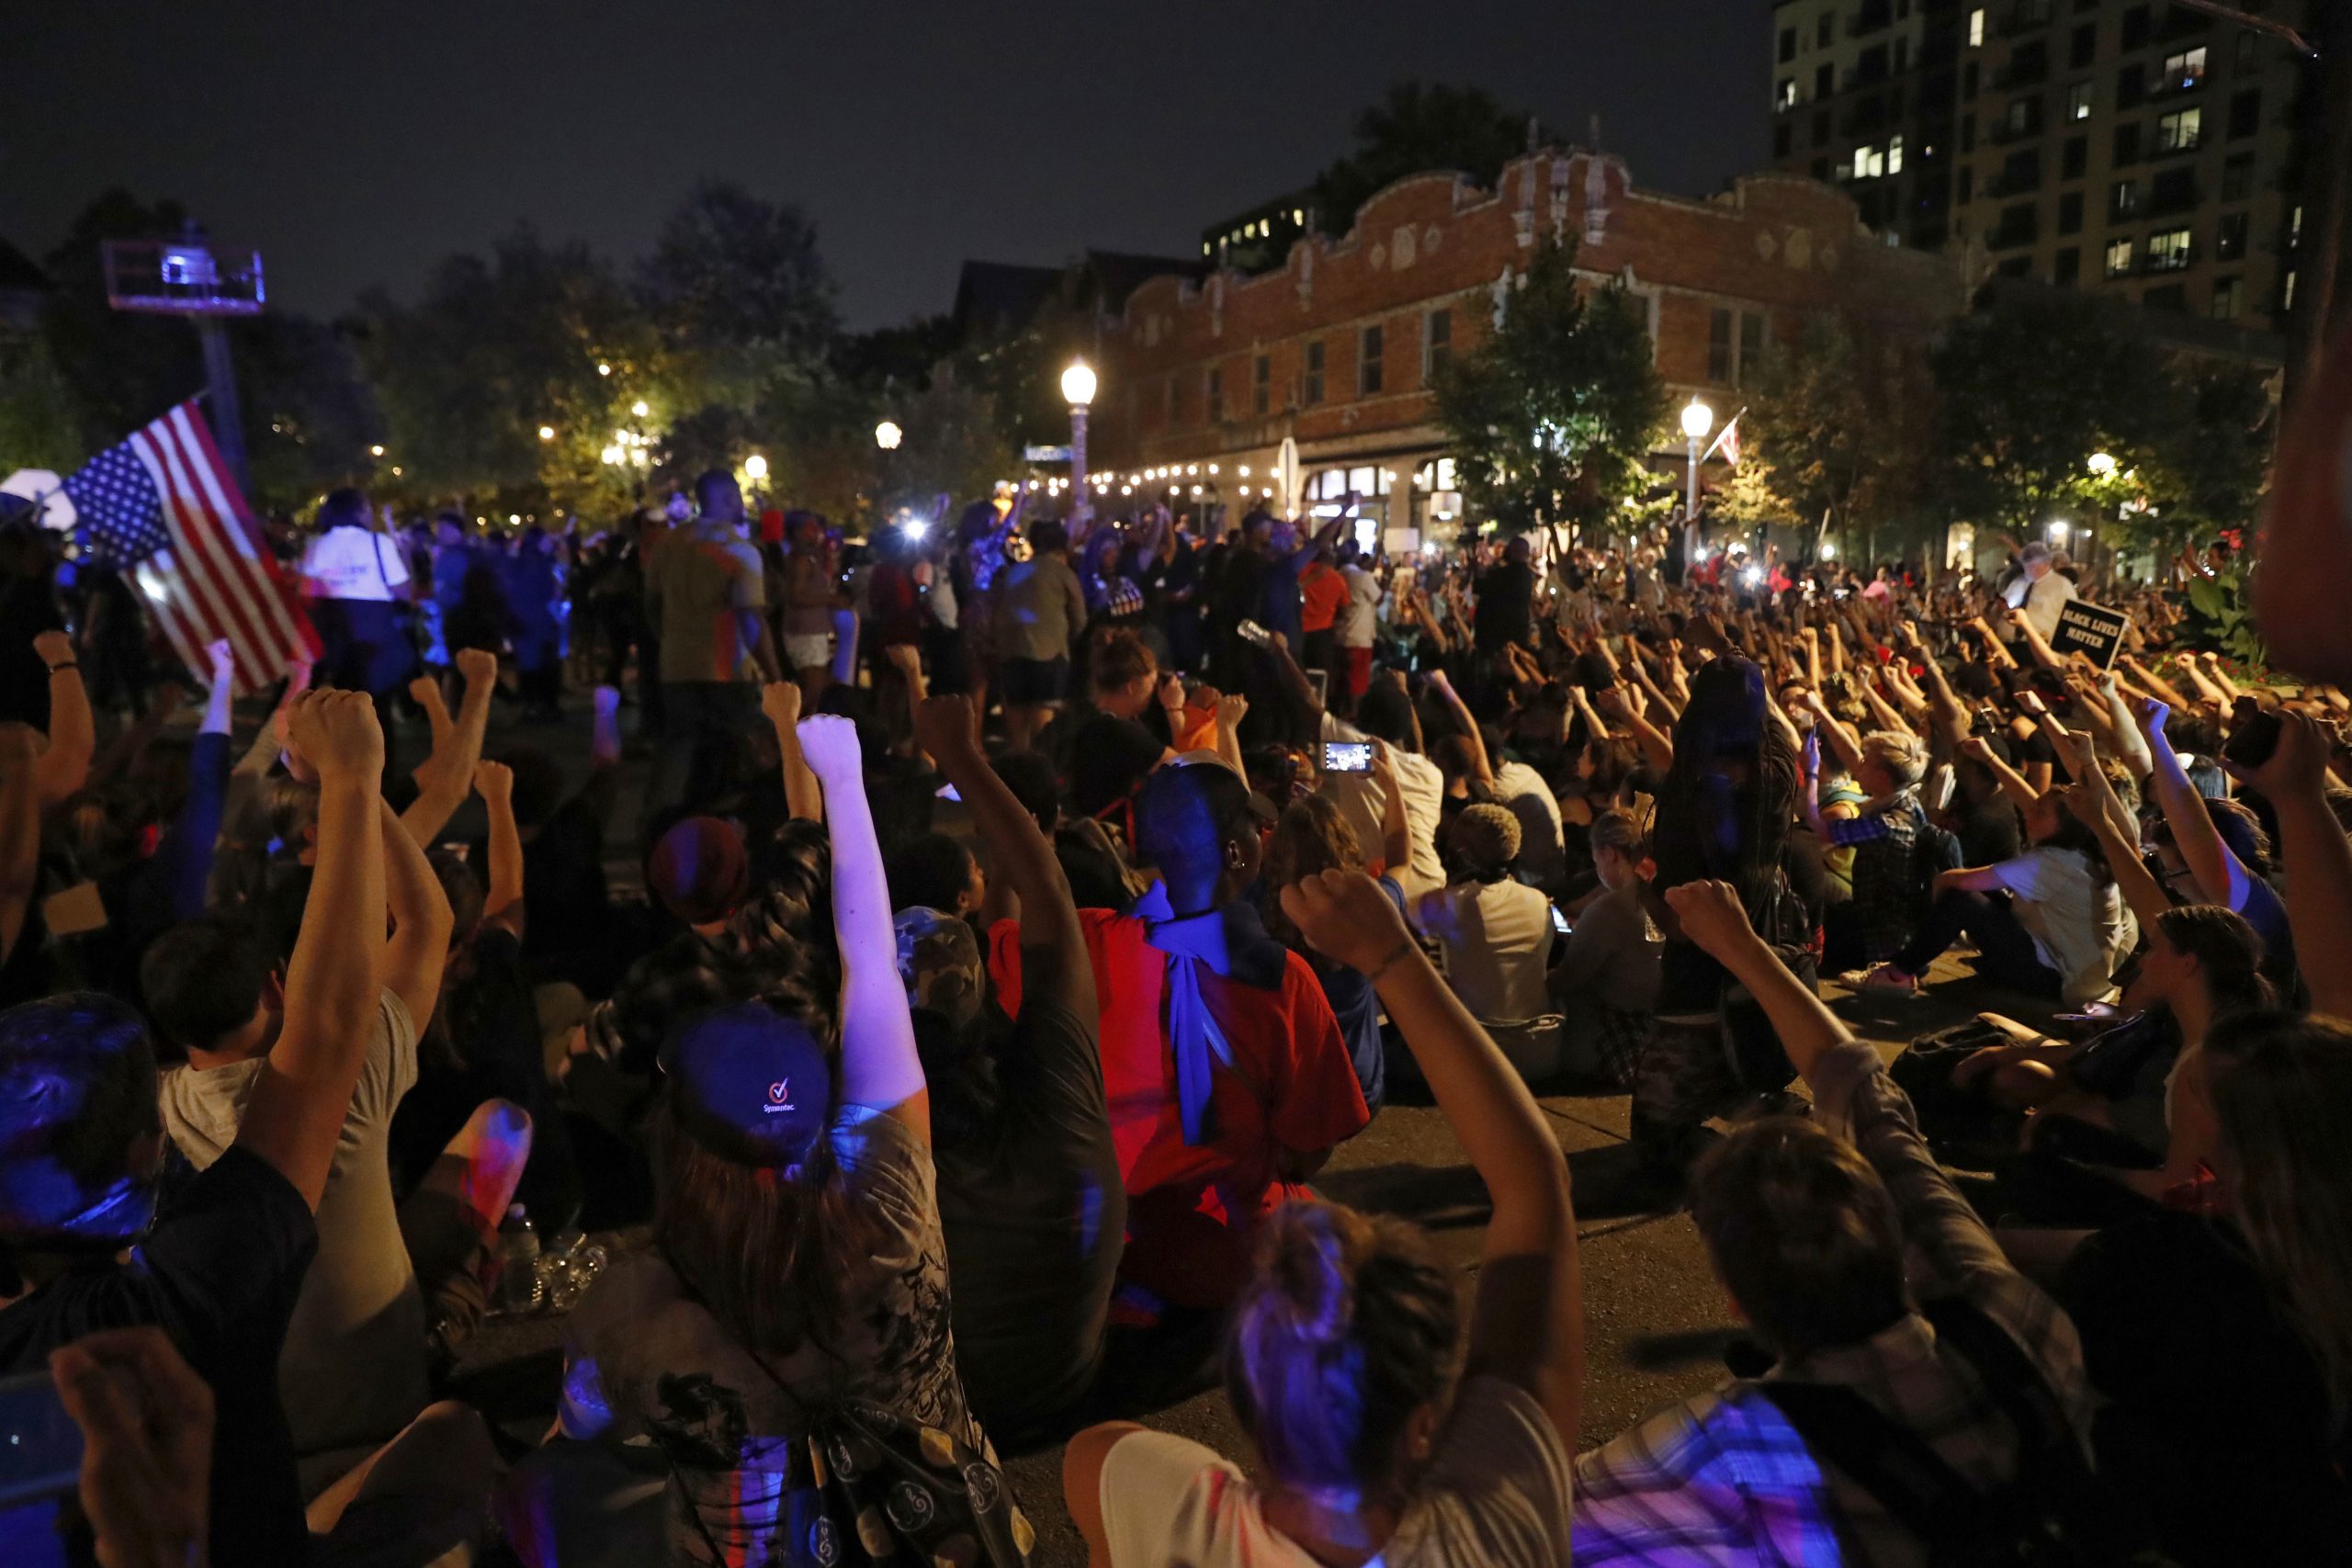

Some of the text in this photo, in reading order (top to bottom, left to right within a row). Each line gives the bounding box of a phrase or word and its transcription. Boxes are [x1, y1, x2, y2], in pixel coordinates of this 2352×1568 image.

[2063, 610, 2119, 637] BLACK LIVES
[2065, 626, 2105, 649] MATTER
